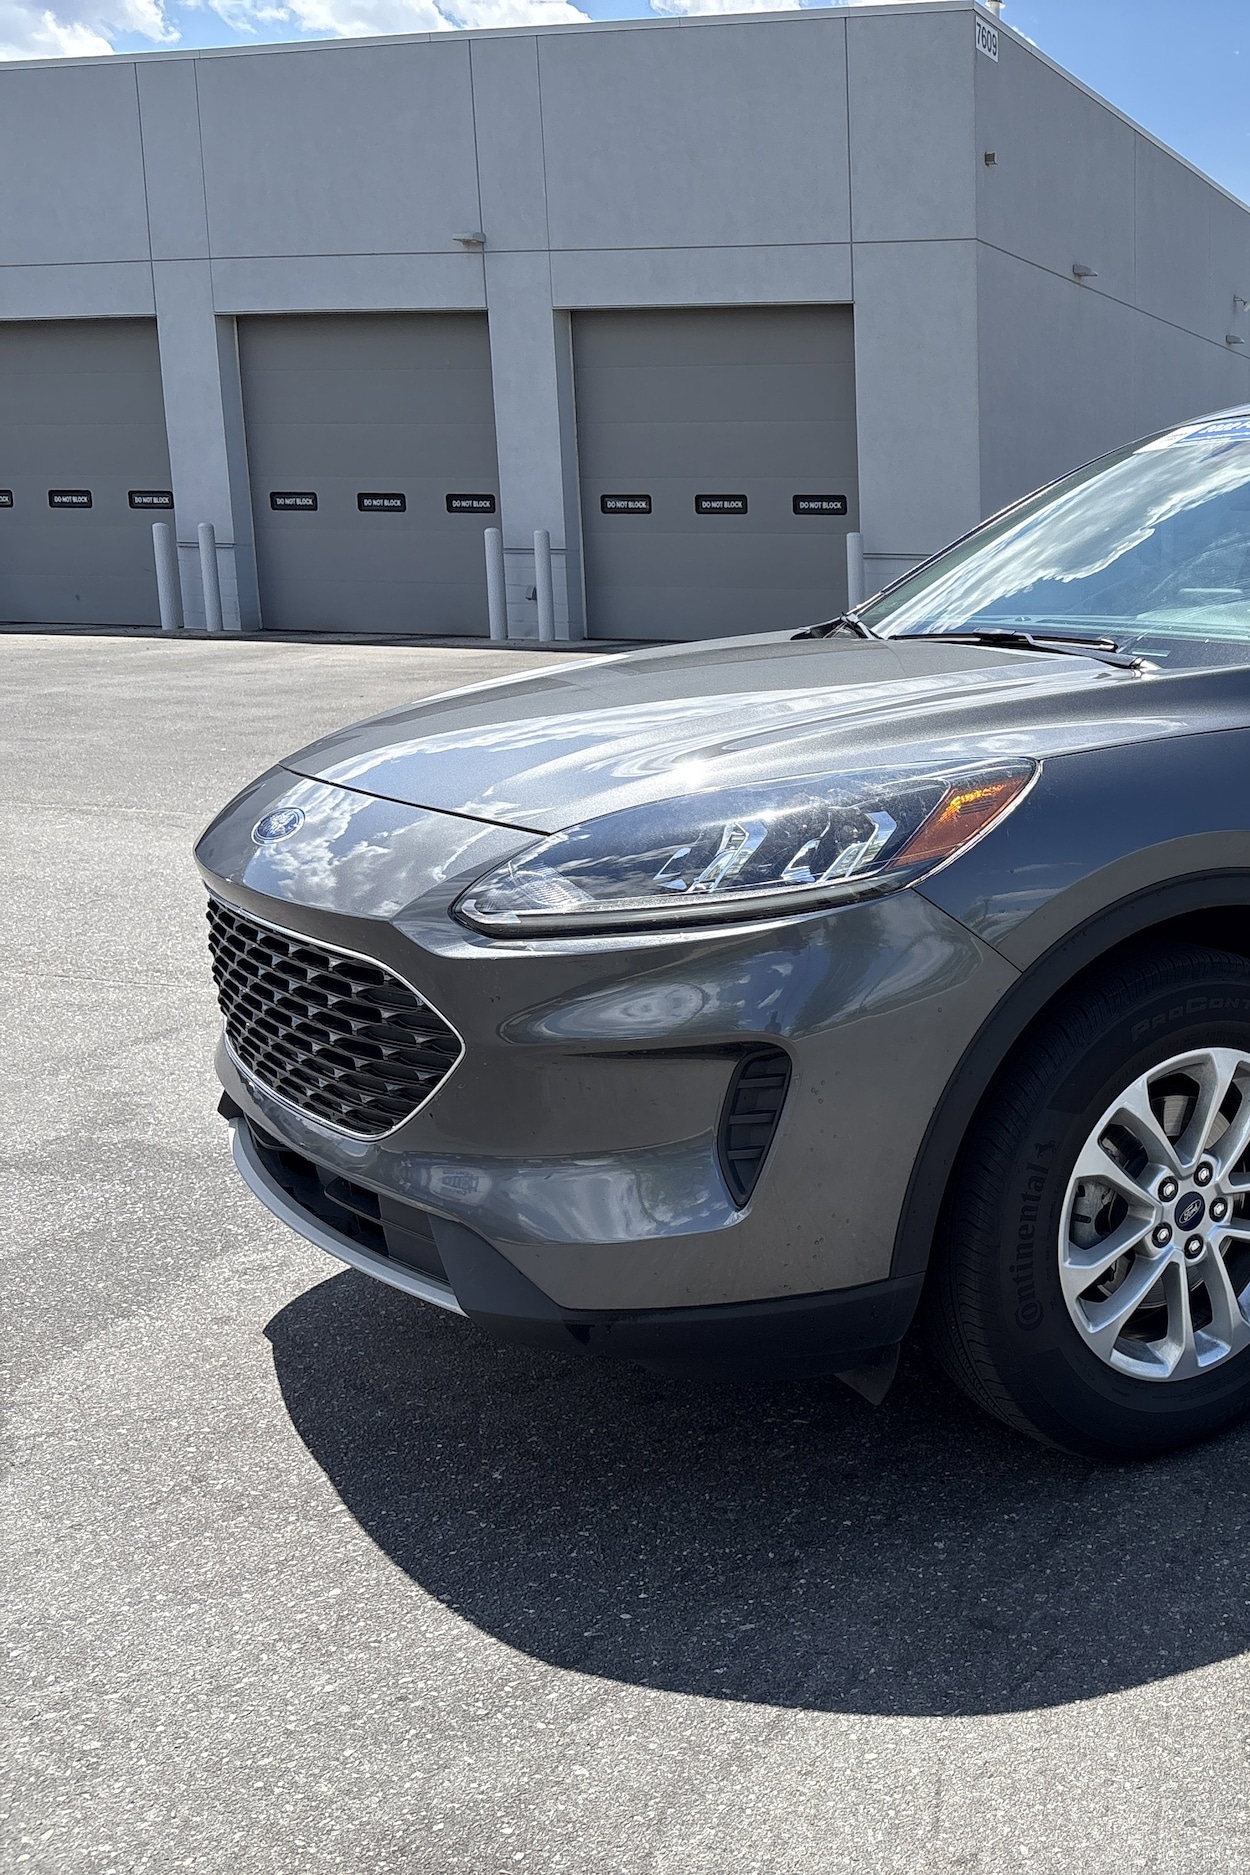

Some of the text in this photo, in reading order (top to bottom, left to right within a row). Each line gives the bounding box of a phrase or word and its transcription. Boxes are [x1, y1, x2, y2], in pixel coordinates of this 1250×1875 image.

[977, 22, 997, 56] 7609
[800, 501, 841, 509] DO NOT BLOCK
[1009, 1163, 1050, 1332] Continental
